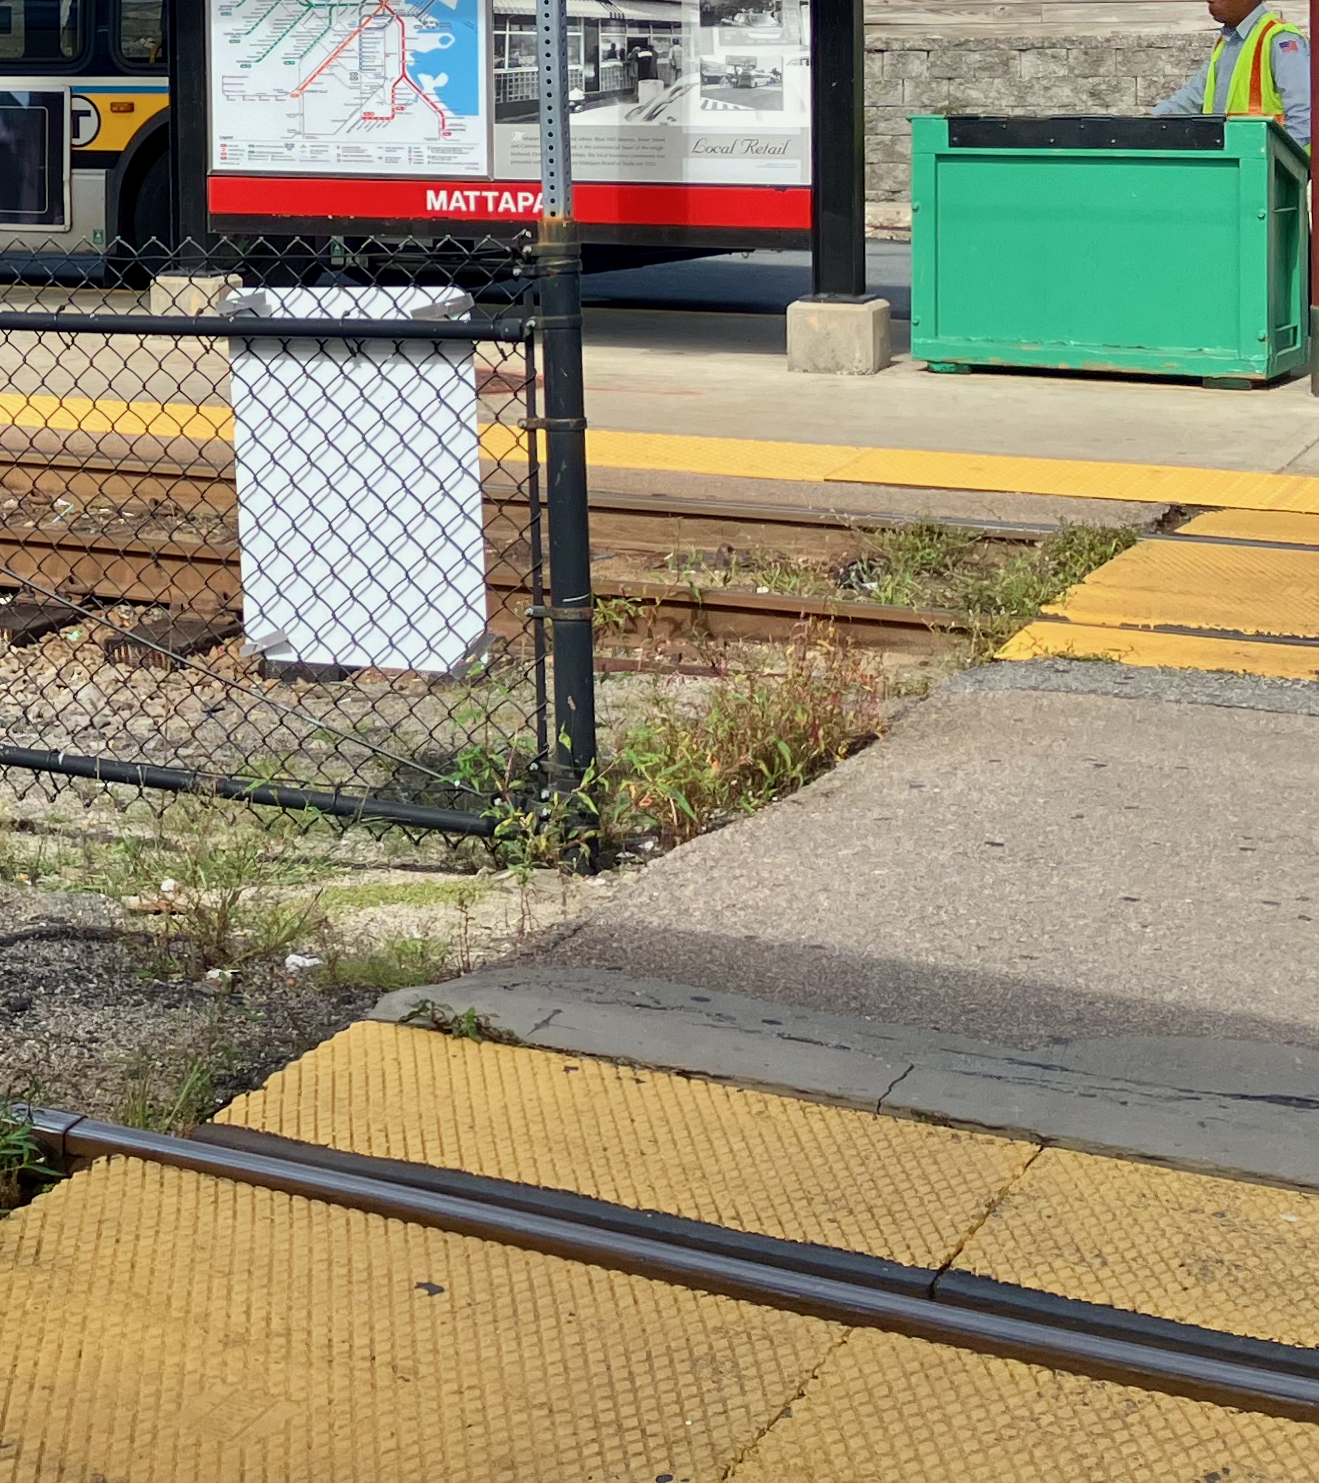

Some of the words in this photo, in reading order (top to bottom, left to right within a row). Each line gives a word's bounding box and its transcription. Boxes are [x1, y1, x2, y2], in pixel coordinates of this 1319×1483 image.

[691, 137, 739, 154] Local
[741, 138, 792, 155] Retail
[426, 189, 544, 214] MATTAPA
